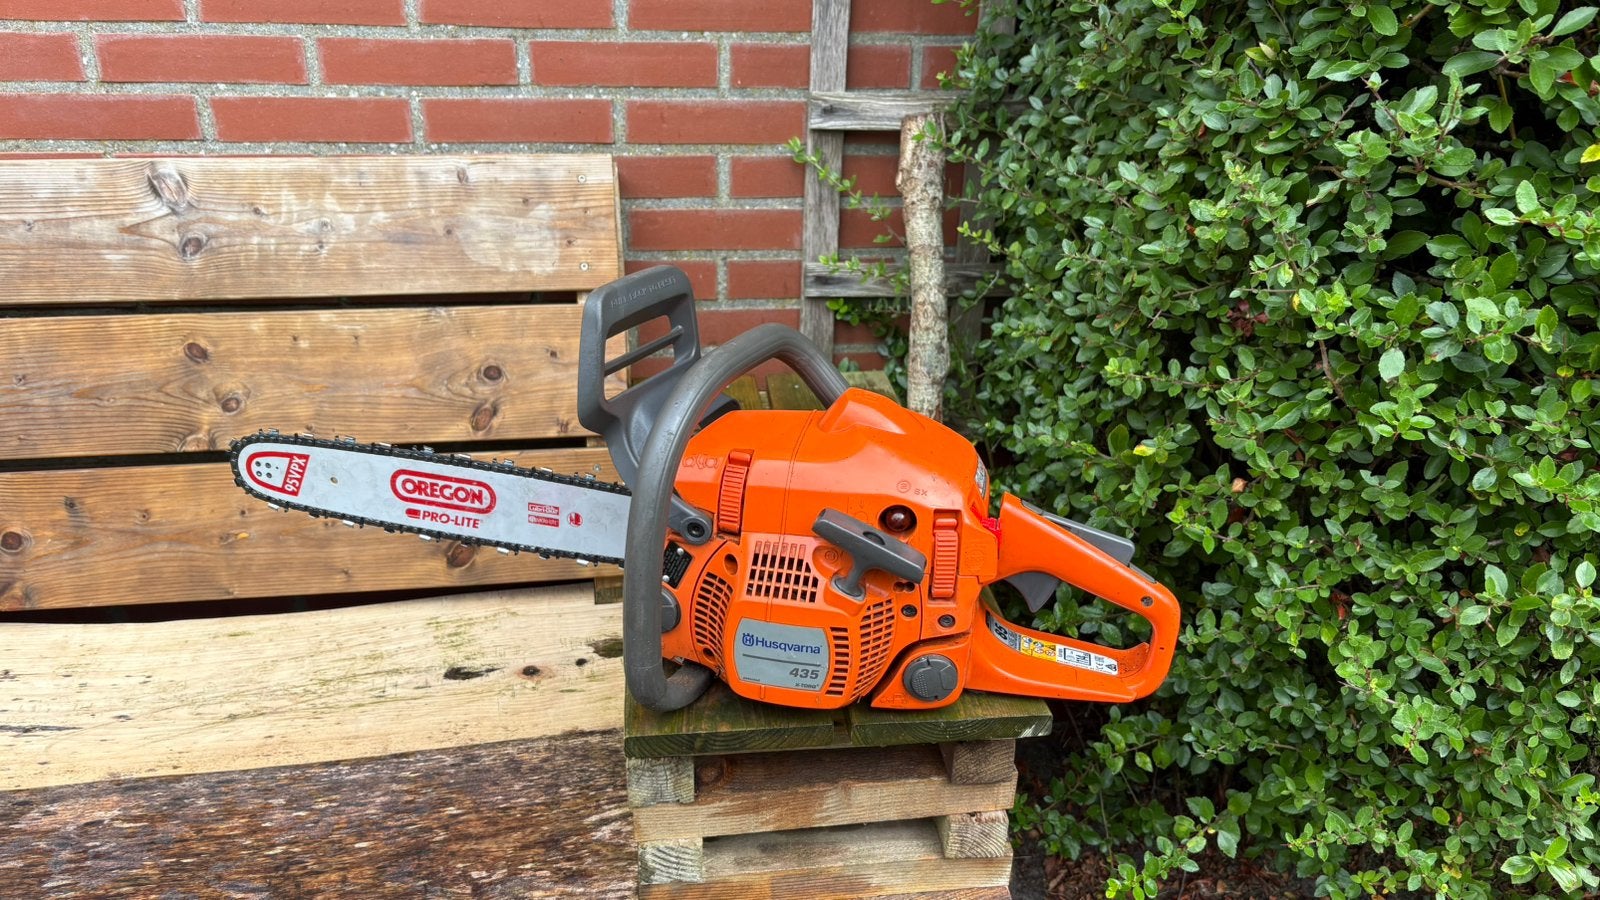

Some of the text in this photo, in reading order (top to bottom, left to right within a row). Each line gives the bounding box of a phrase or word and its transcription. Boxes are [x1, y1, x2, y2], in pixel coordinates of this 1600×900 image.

[284, 455, 307, 492] 95VPX
[401, 478, 483, 505] OREGON
[422, 510, 480, 529] PRO-LITE
[755, 636, 821, 654] Husqvarna
[789, 667, 820, 680] 435
